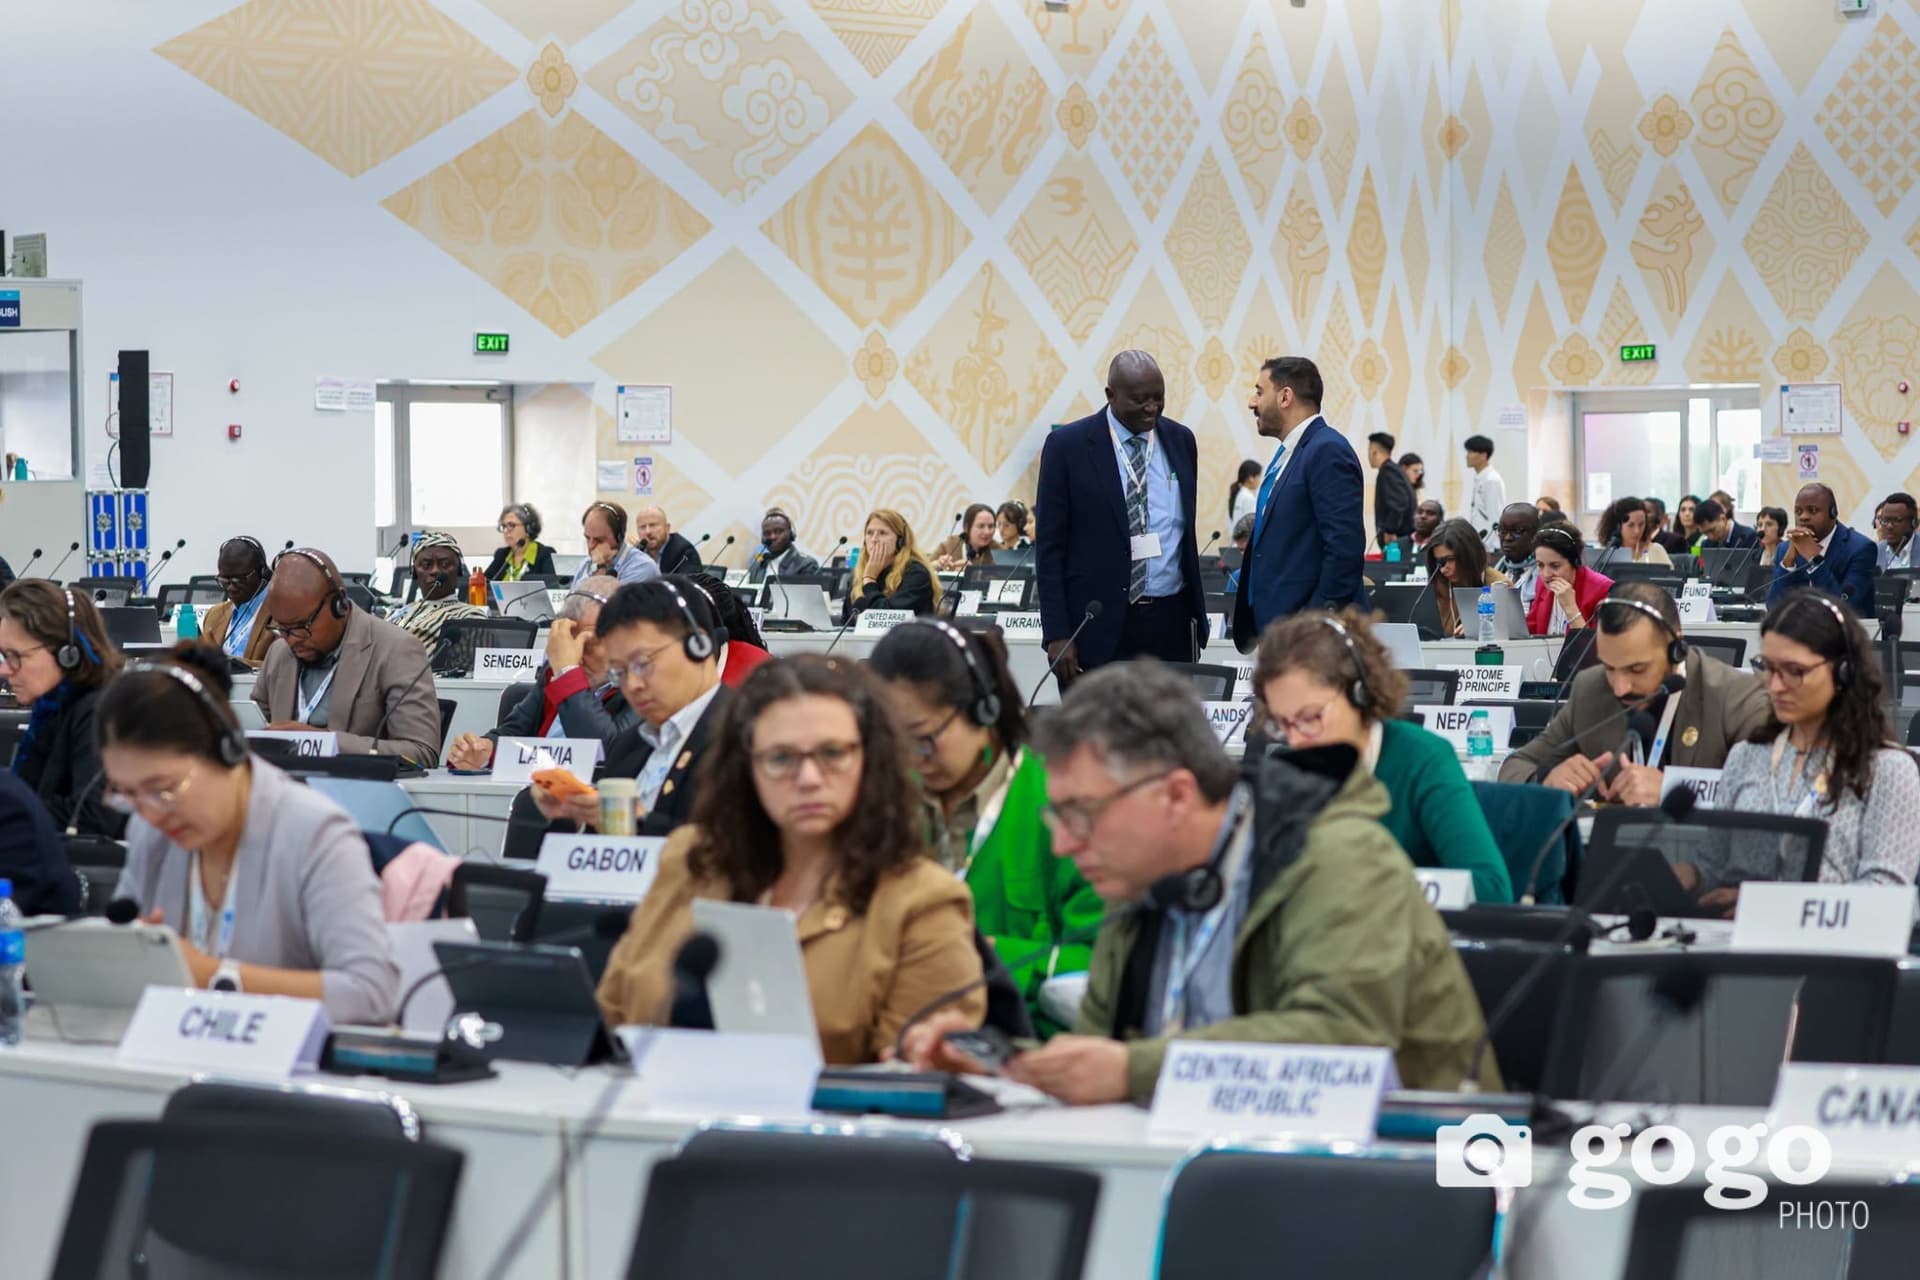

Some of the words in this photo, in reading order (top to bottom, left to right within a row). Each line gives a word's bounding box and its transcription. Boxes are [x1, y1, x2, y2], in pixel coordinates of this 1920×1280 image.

[0, 307, 18, 317] LISH
[478, 335, 507, 350] EXIT
[1622, 347, 1654, 360] EXIT
[1684, 587, 1708, 597] FUND
[864, 612, 888, 621] UNITED
[888, 613, 906, 621] ARAB
[1005, 617, 1041, 629] UKRAIN
[483, 654, 534, 669] SENEGAL
[1476, 669, 1504, 680] TOME
[1464, 682, 1511, 693] PRINCIPE
[1436, 712, 1473, 731] NEP
[567, 847, 648, 872] GABON
[1800, 899, 1850, 928] FIJI
[177, 1005, 266, 1044] CHILE
[1172, 1054, 1269, 1083] CENTRAL
[1276, 1057, 1374, 1086] AFRICAN
[1209, 1085, 1321, 1116] REPUBLIC
